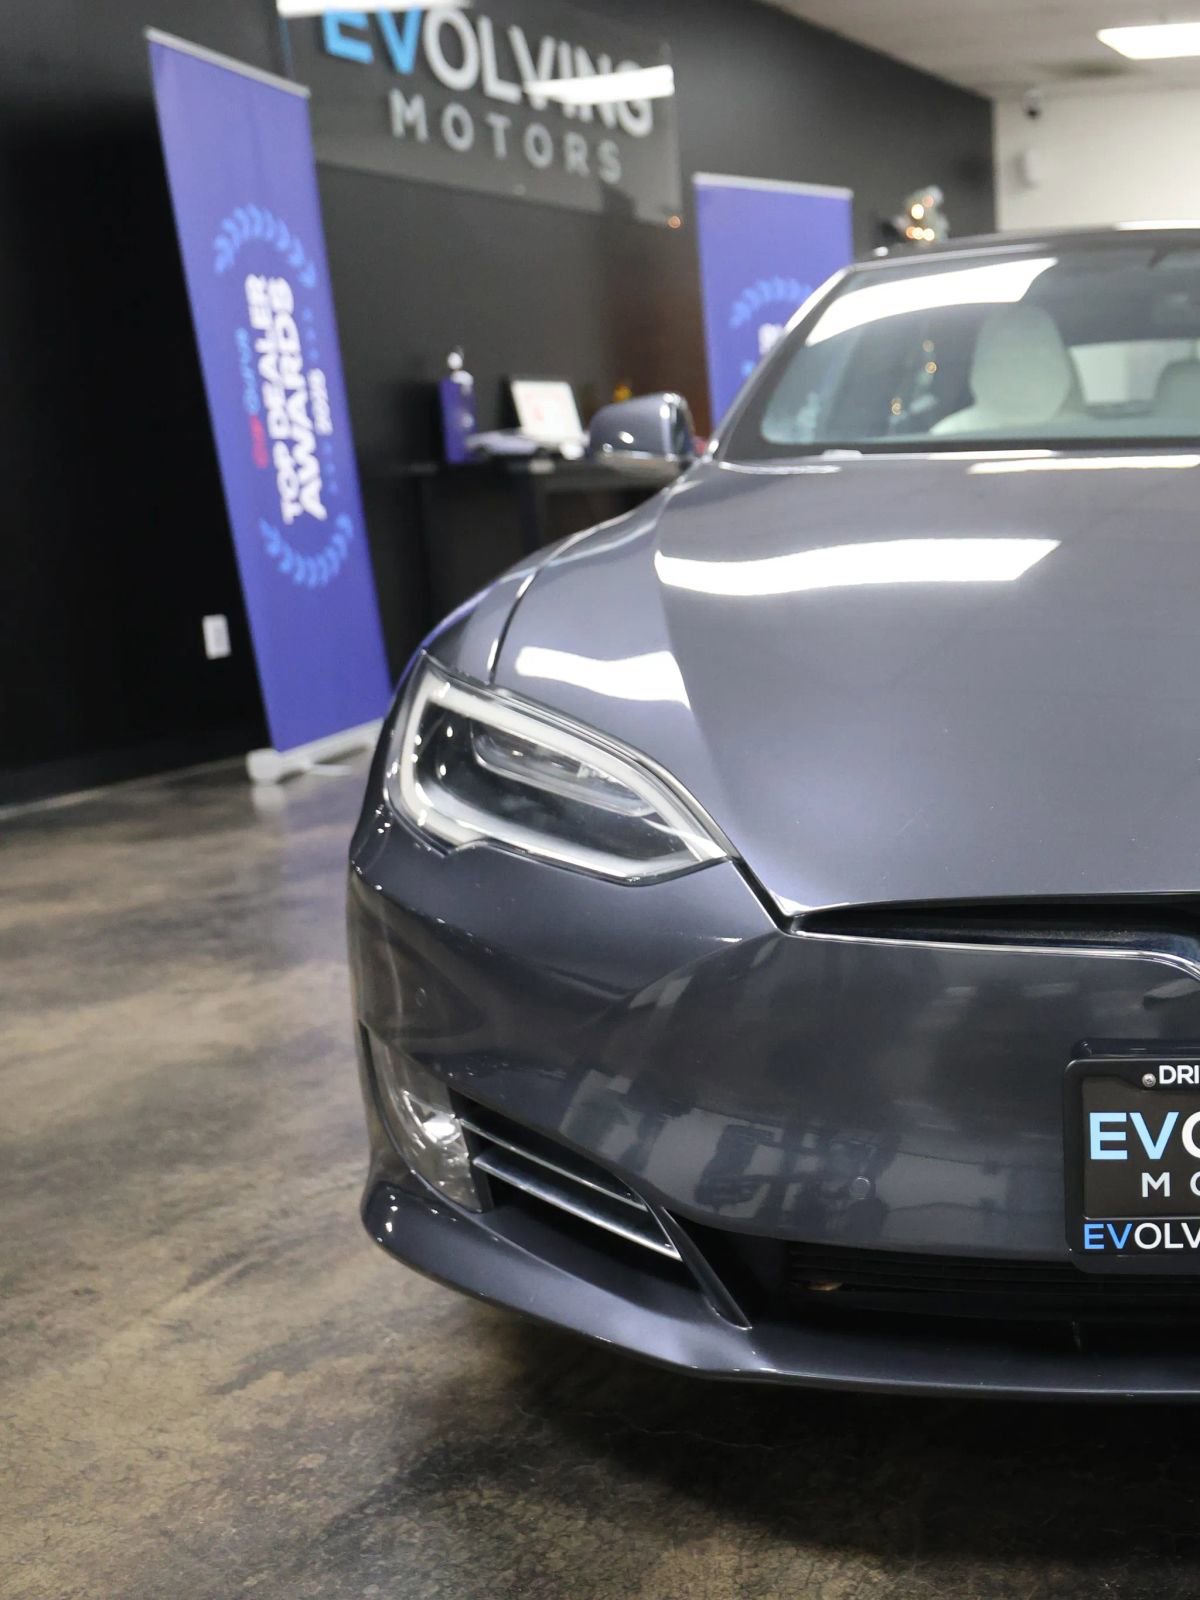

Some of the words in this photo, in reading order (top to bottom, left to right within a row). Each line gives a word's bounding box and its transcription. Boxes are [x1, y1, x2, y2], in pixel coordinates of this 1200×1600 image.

[322, 8, 654, 138] EVOLVING
[389, 87, 623, 184] MOTORS
[245, 273, 292, 440] DEALER
[268, 276, 327, 520] AWARDS
[273, 439, 302, 524] TOP
